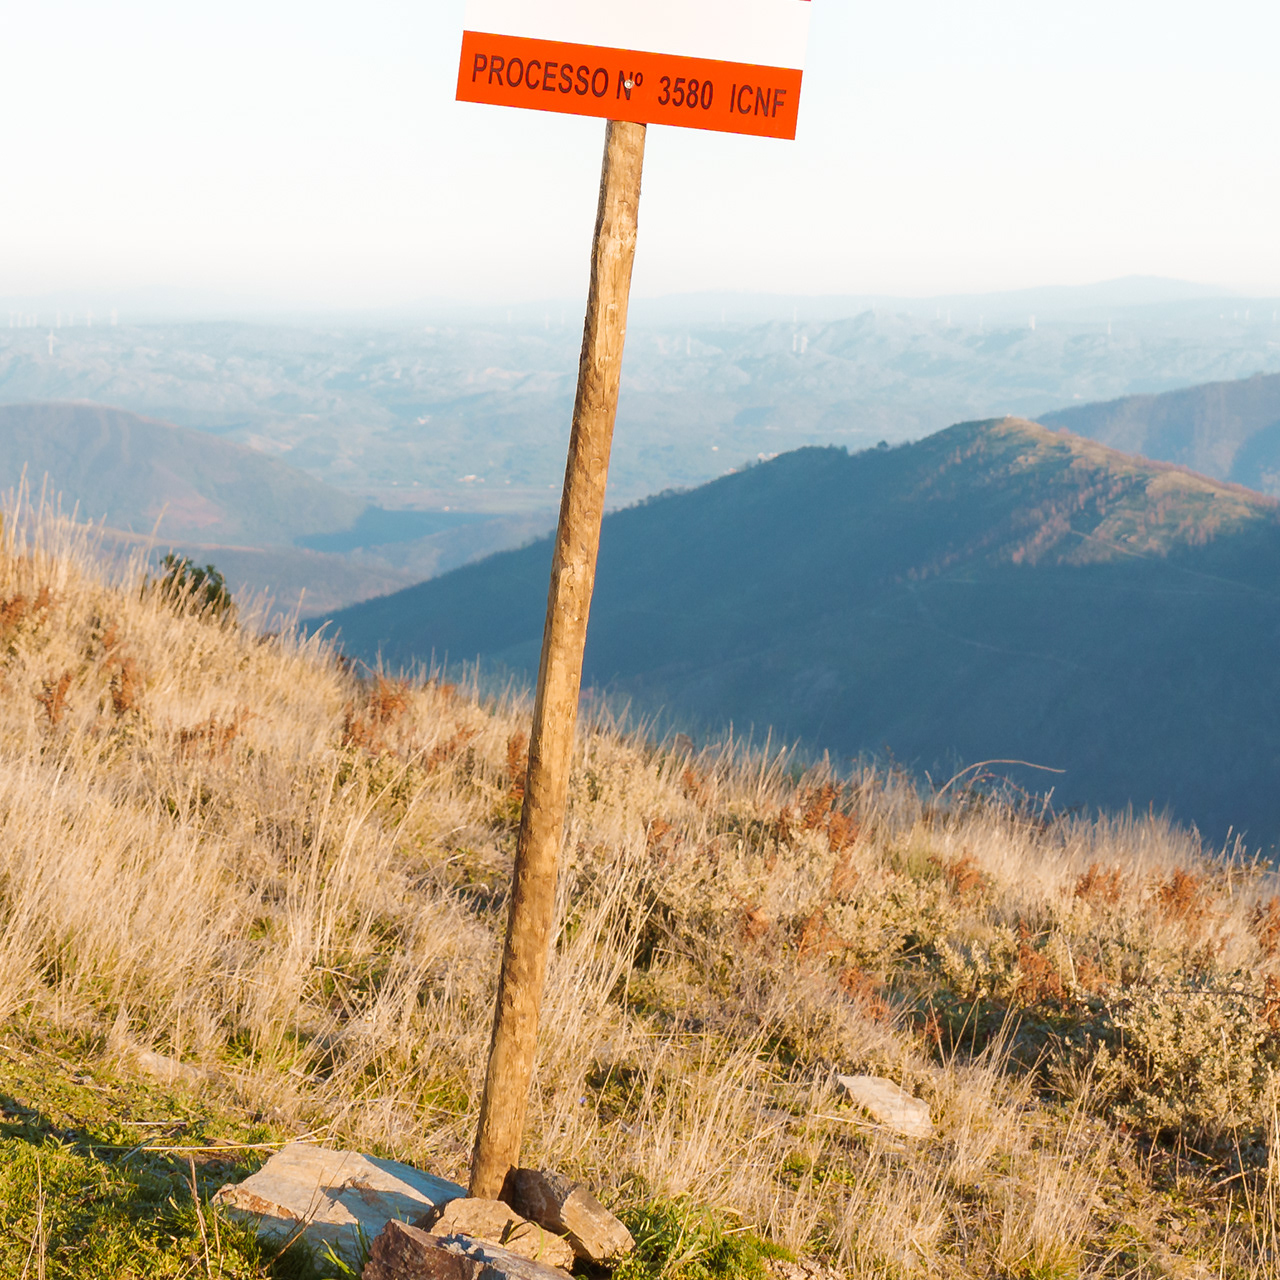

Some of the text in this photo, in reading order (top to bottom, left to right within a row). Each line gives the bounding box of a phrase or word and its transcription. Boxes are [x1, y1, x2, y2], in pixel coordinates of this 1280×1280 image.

[472, 54, 608, 97] PROCESSO
[658, 76, 713, 109] 3580
[730, 84, 786, 117] ICNF
